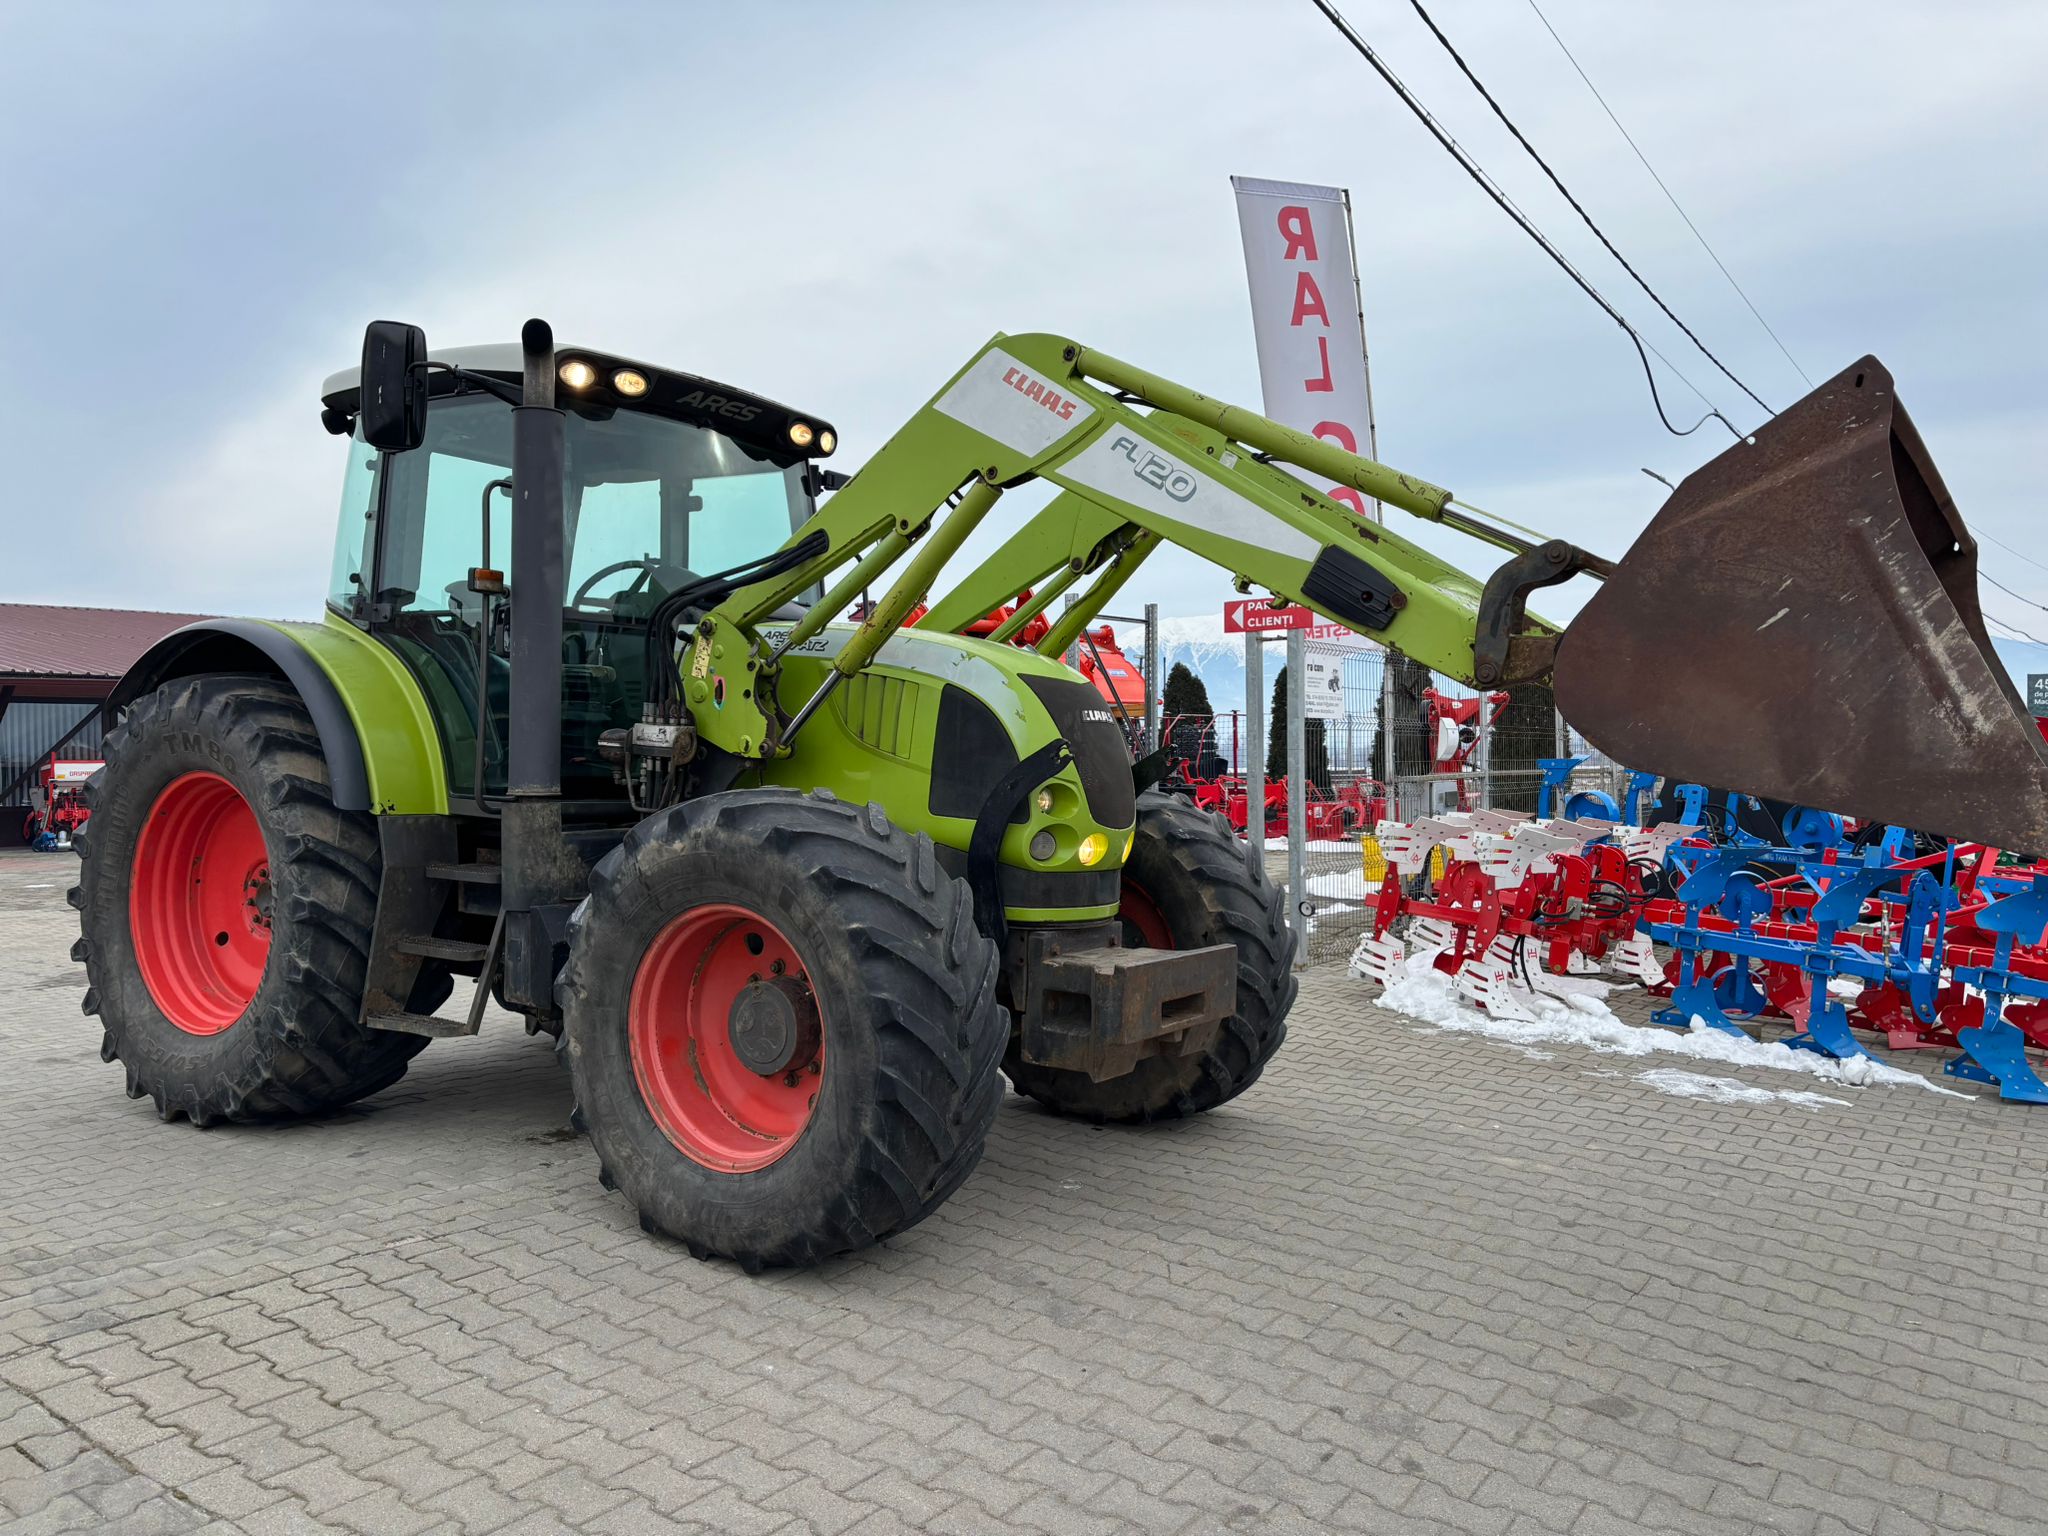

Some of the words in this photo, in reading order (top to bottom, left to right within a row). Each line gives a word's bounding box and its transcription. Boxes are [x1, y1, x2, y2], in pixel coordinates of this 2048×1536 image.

[1001, 366, 1078, 421] CLAAS
[676, 389, 763, 422] ARES
[1247, 601, 1303, 611] PARR
[1247, 615, 1293, 627] CLIENȚI
[764, 630, 789, 640] ARE
[1082, 709, 1113, 722] CLAAS
